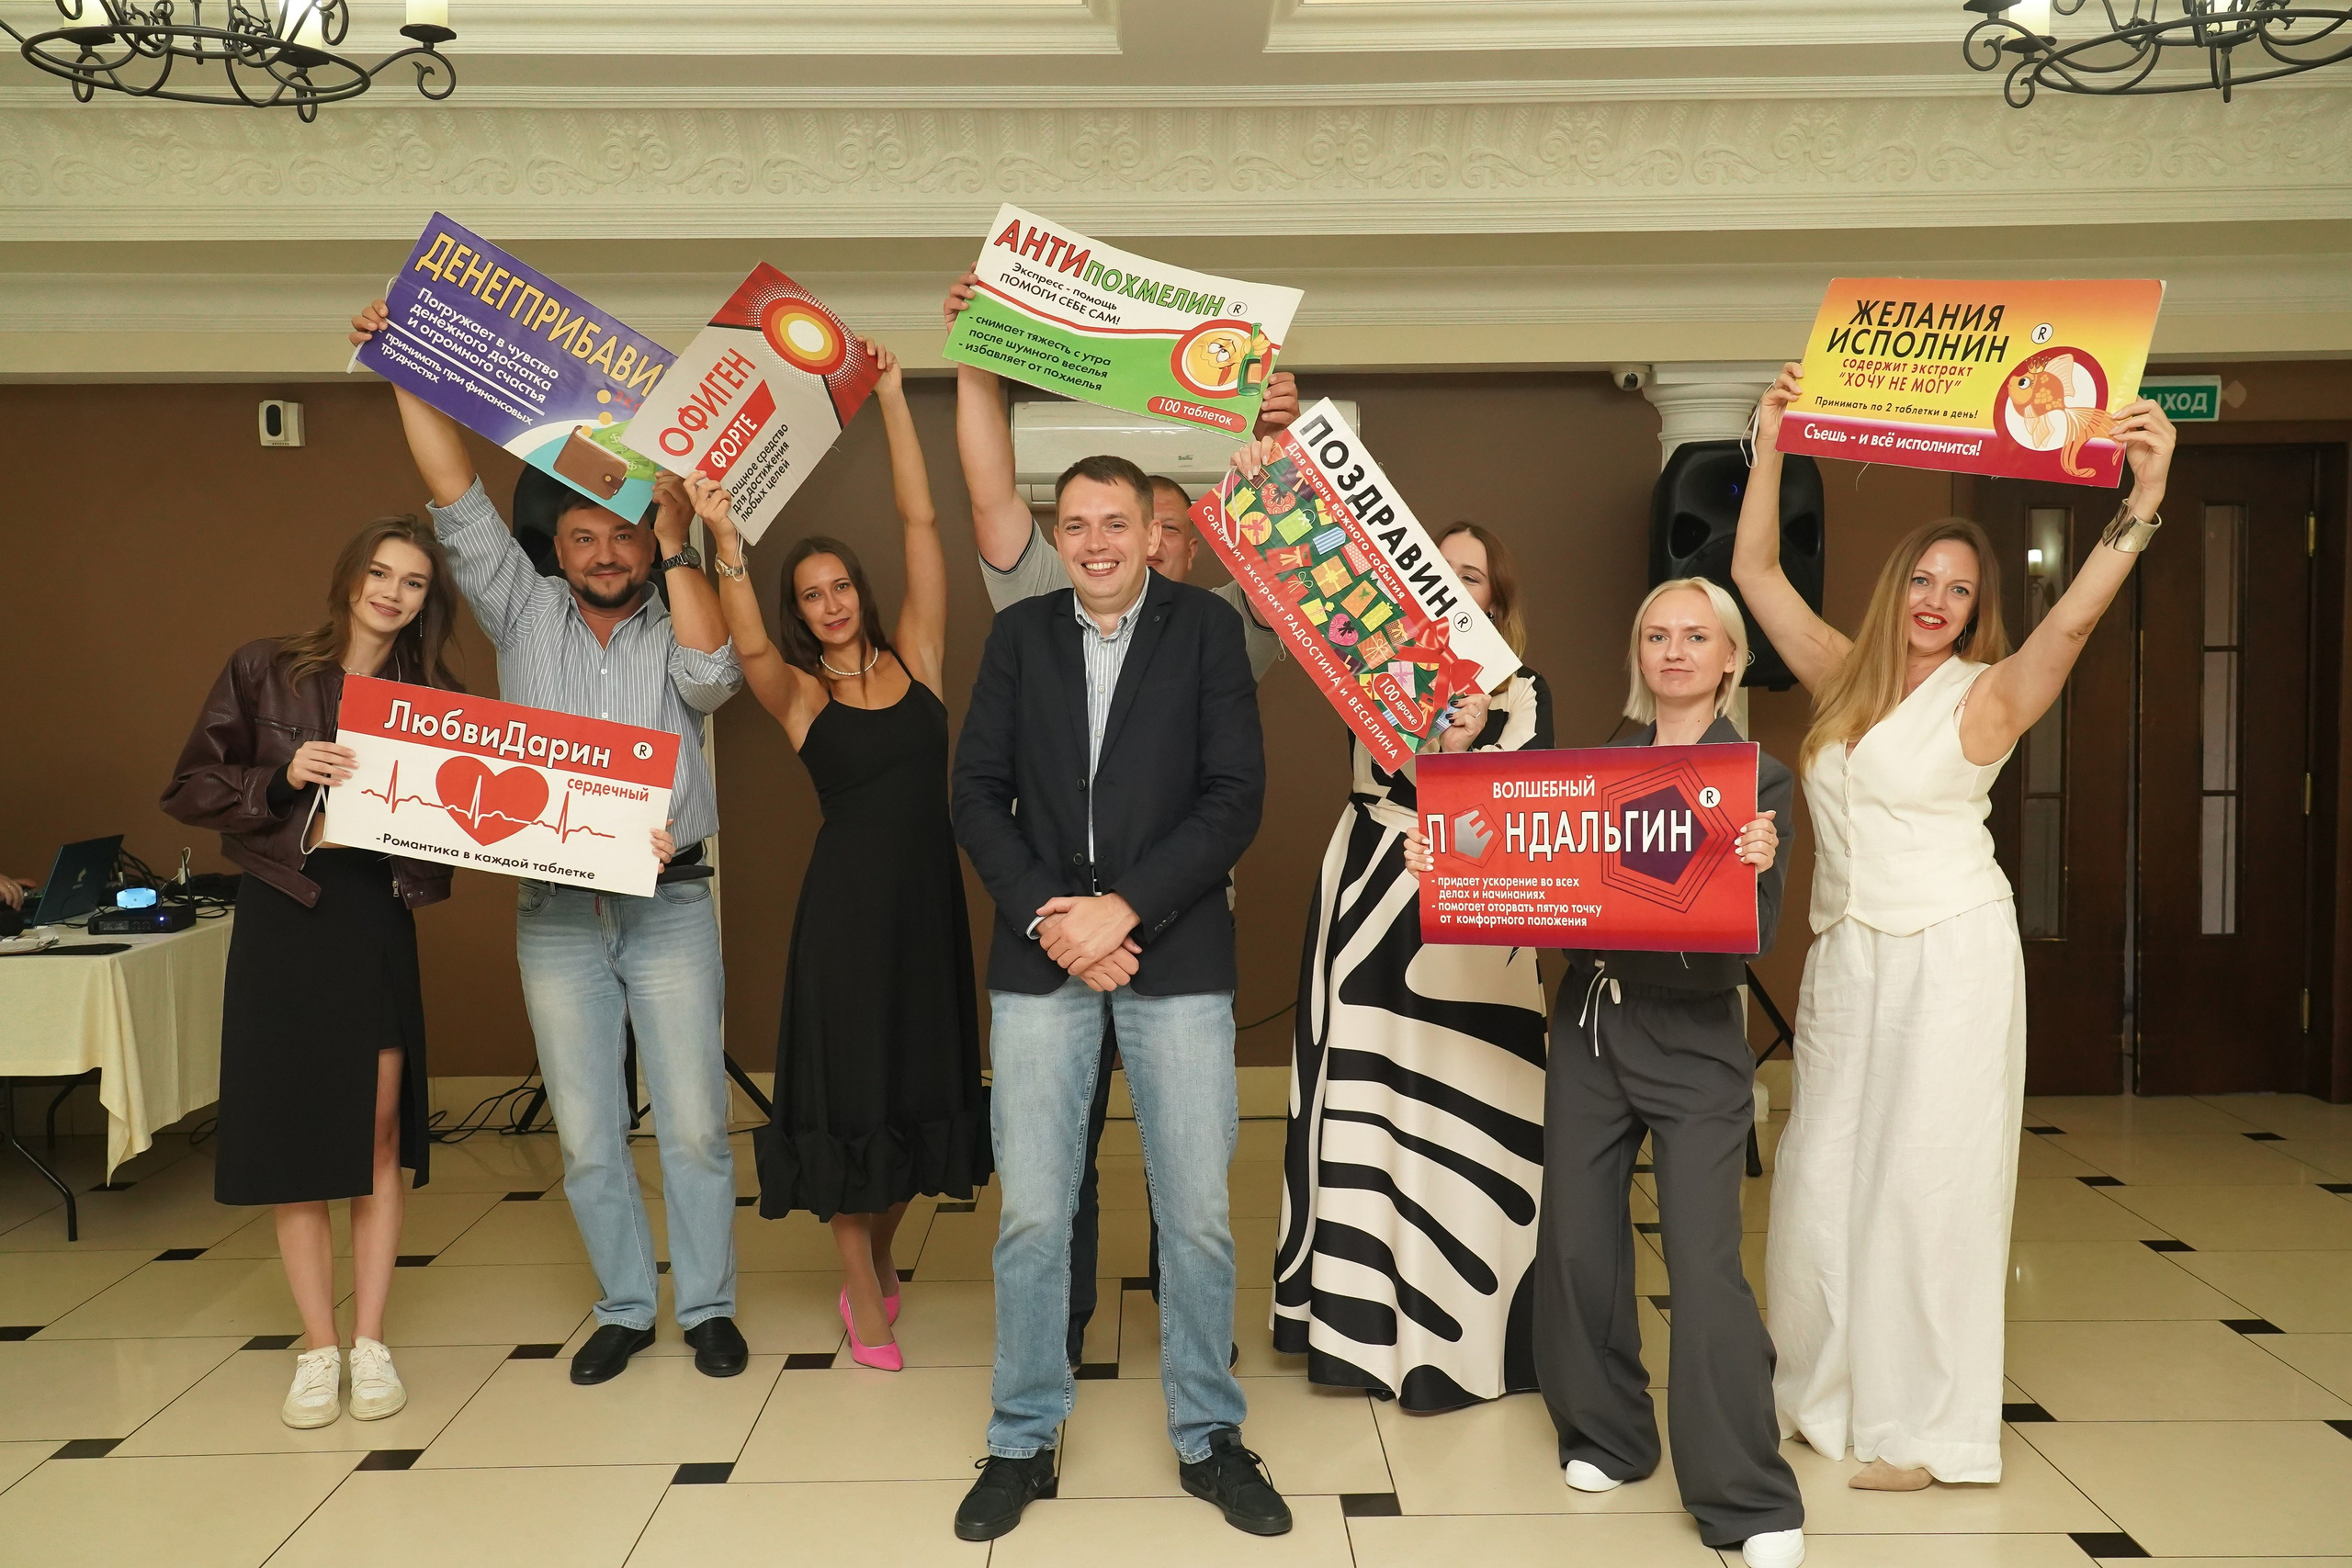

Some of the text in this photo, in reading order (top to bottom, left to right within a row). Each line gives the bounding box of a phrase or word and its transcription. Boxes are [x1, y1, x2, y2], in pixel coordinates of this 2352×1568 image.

[994, 219, 1226, 317] АНТИПОХМЕЛИН
[1012, 263, 1065, 291] Экспресс
[1072, 288, 1117, 311] помощь
[414, 231, 665, 397] ДЕНЕГПРИБАВИ
[1000, 273, 1121, 325] ПОМОГИ СЕБЕ САМ!
[1849, 299, 2006, 333] ЖЕЛАНИЯ
[410, 303, 552, 392] денежного достатка
[417, 287, 560, 380] Погружает в чувство
[968, 329, 1108, 379] после шумного веселья
[976, 314, 1024, 336] снимает
[1026, 330, 1070, 355] тяжесть
[1073, 348, 1080, 356] с
[1082, 351, 1112, 368] утра
[1826, 328, 2009, 363] ИСПОЛНИН
[380, 343, 440, 384] трудностях
[385, 333, 443, 371] принимать
[442, 367, 465, 386] при
[466, 380, 534, 425] финансовых
[407, 316, 546, 404] и огромного счастья
[965, 342, 1026, 368] избавляет
[1028, 362, 1041, 372] от
[1043, 367, 1102, 391] похмелья
[1842, 357, 1973, 378] содержит экстракт
[1888, 376, 1912, 392] НЕ
[659, 347, 756, 457] ОФИГЕН
[1158, 398, 1233, 426] 100 таблеток
[1815, 396, 1979, 421] Принимать по 2 таблетки в день!
[2143, 392, 2208, 413] ХОД
[710, 413, 758, 468] ФОРТЕ
[757, 424, 788, 463] средство
[1804, 423, 1848, 445] Съешь
[1858, 434, 1869, 446] и
[1871, 431, 1894, 448] всё
[1896, 436, 1983, 457] исполнится!
[732, 442, 789, 514] для достижения
[741, 458, 790, 522] любых целей
[1285, 441, 1407, 601] Для очень важного события
[1299, 413, 1458, 619] ПОЗДРАВИН
[1244, 562, 1286, 614] экстракт
[1283, 612, 1340, 689] РАДОСТИНА
[1340, 687, 1349, 697] и
[1347, 694, 1397, 760] ВЕСЕЛИНА
[1377, 678, 1419, 727] 100 драже
[383, 699, 611, 770] ЛюбвиДарин
[567, 777, 649, 803] сердечный
[1492, 775, 1596, 799] ВОЛШЕБНЫЙ
[463, 852, 471, 860] в
[474, 853, 529, 869] каждой
[532, 863, 595, 881] таблетке
[1438, 876, 1479, 888] придает
[1482, 876, 1538, 890] ускорение
[1540, 877, 1554, 887] во
[1555, 877, 1579, 887] всех
[1438, 902, 1485, 914] помогает
[1487, 903, 1534, 915] оторвать
[1536, 903, 1568, 916] пятую
[1571, 903, 1602, 917] точку
[1439, 888, 1545, 902] делах и начинаниях
[1440, 913, 1588, 929] от комфортного положения
